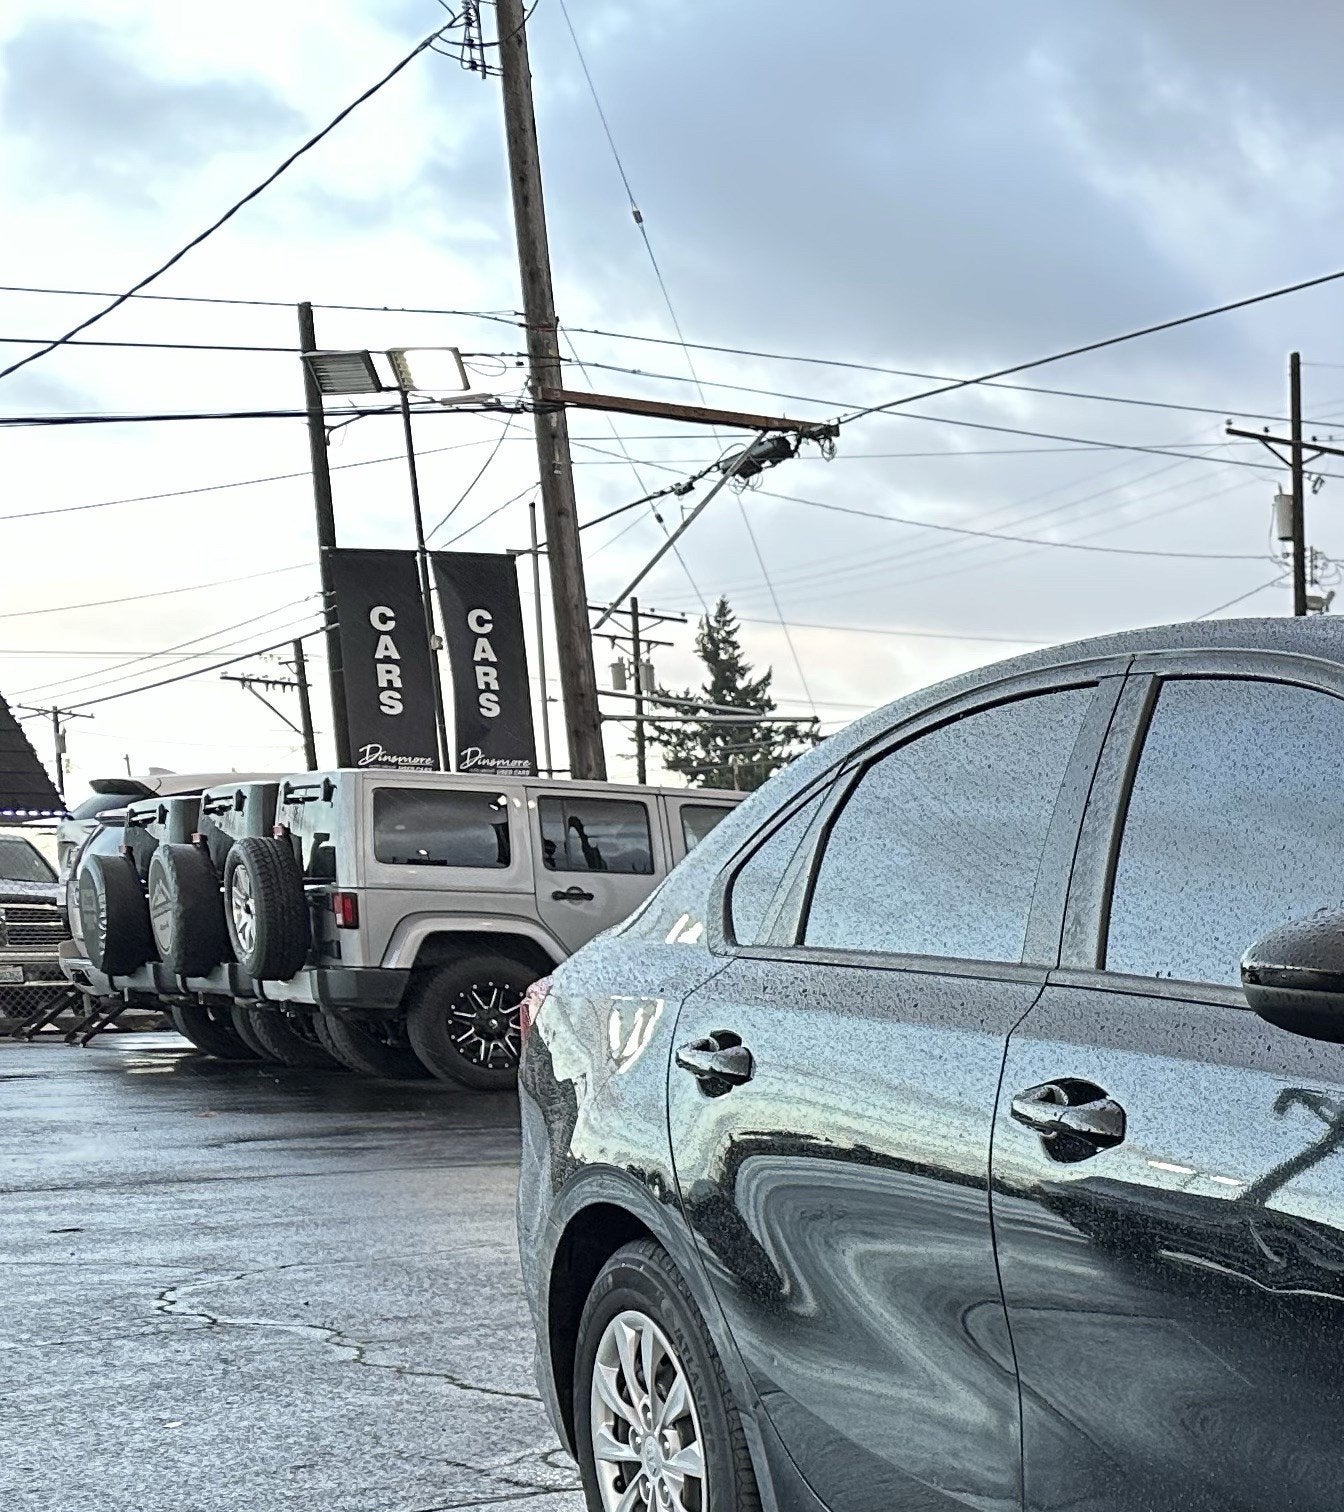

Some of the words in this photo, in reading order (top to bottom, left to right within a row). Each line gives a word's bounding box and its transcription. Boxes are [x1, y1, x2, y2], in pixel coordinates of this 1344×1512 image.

[369, 605, 404, 716] CARS
[467, 608, 501, 718] CARS
[358, 744, 434, 766] Dinsmore
[460, 747, 532, 769] Dinsmore
